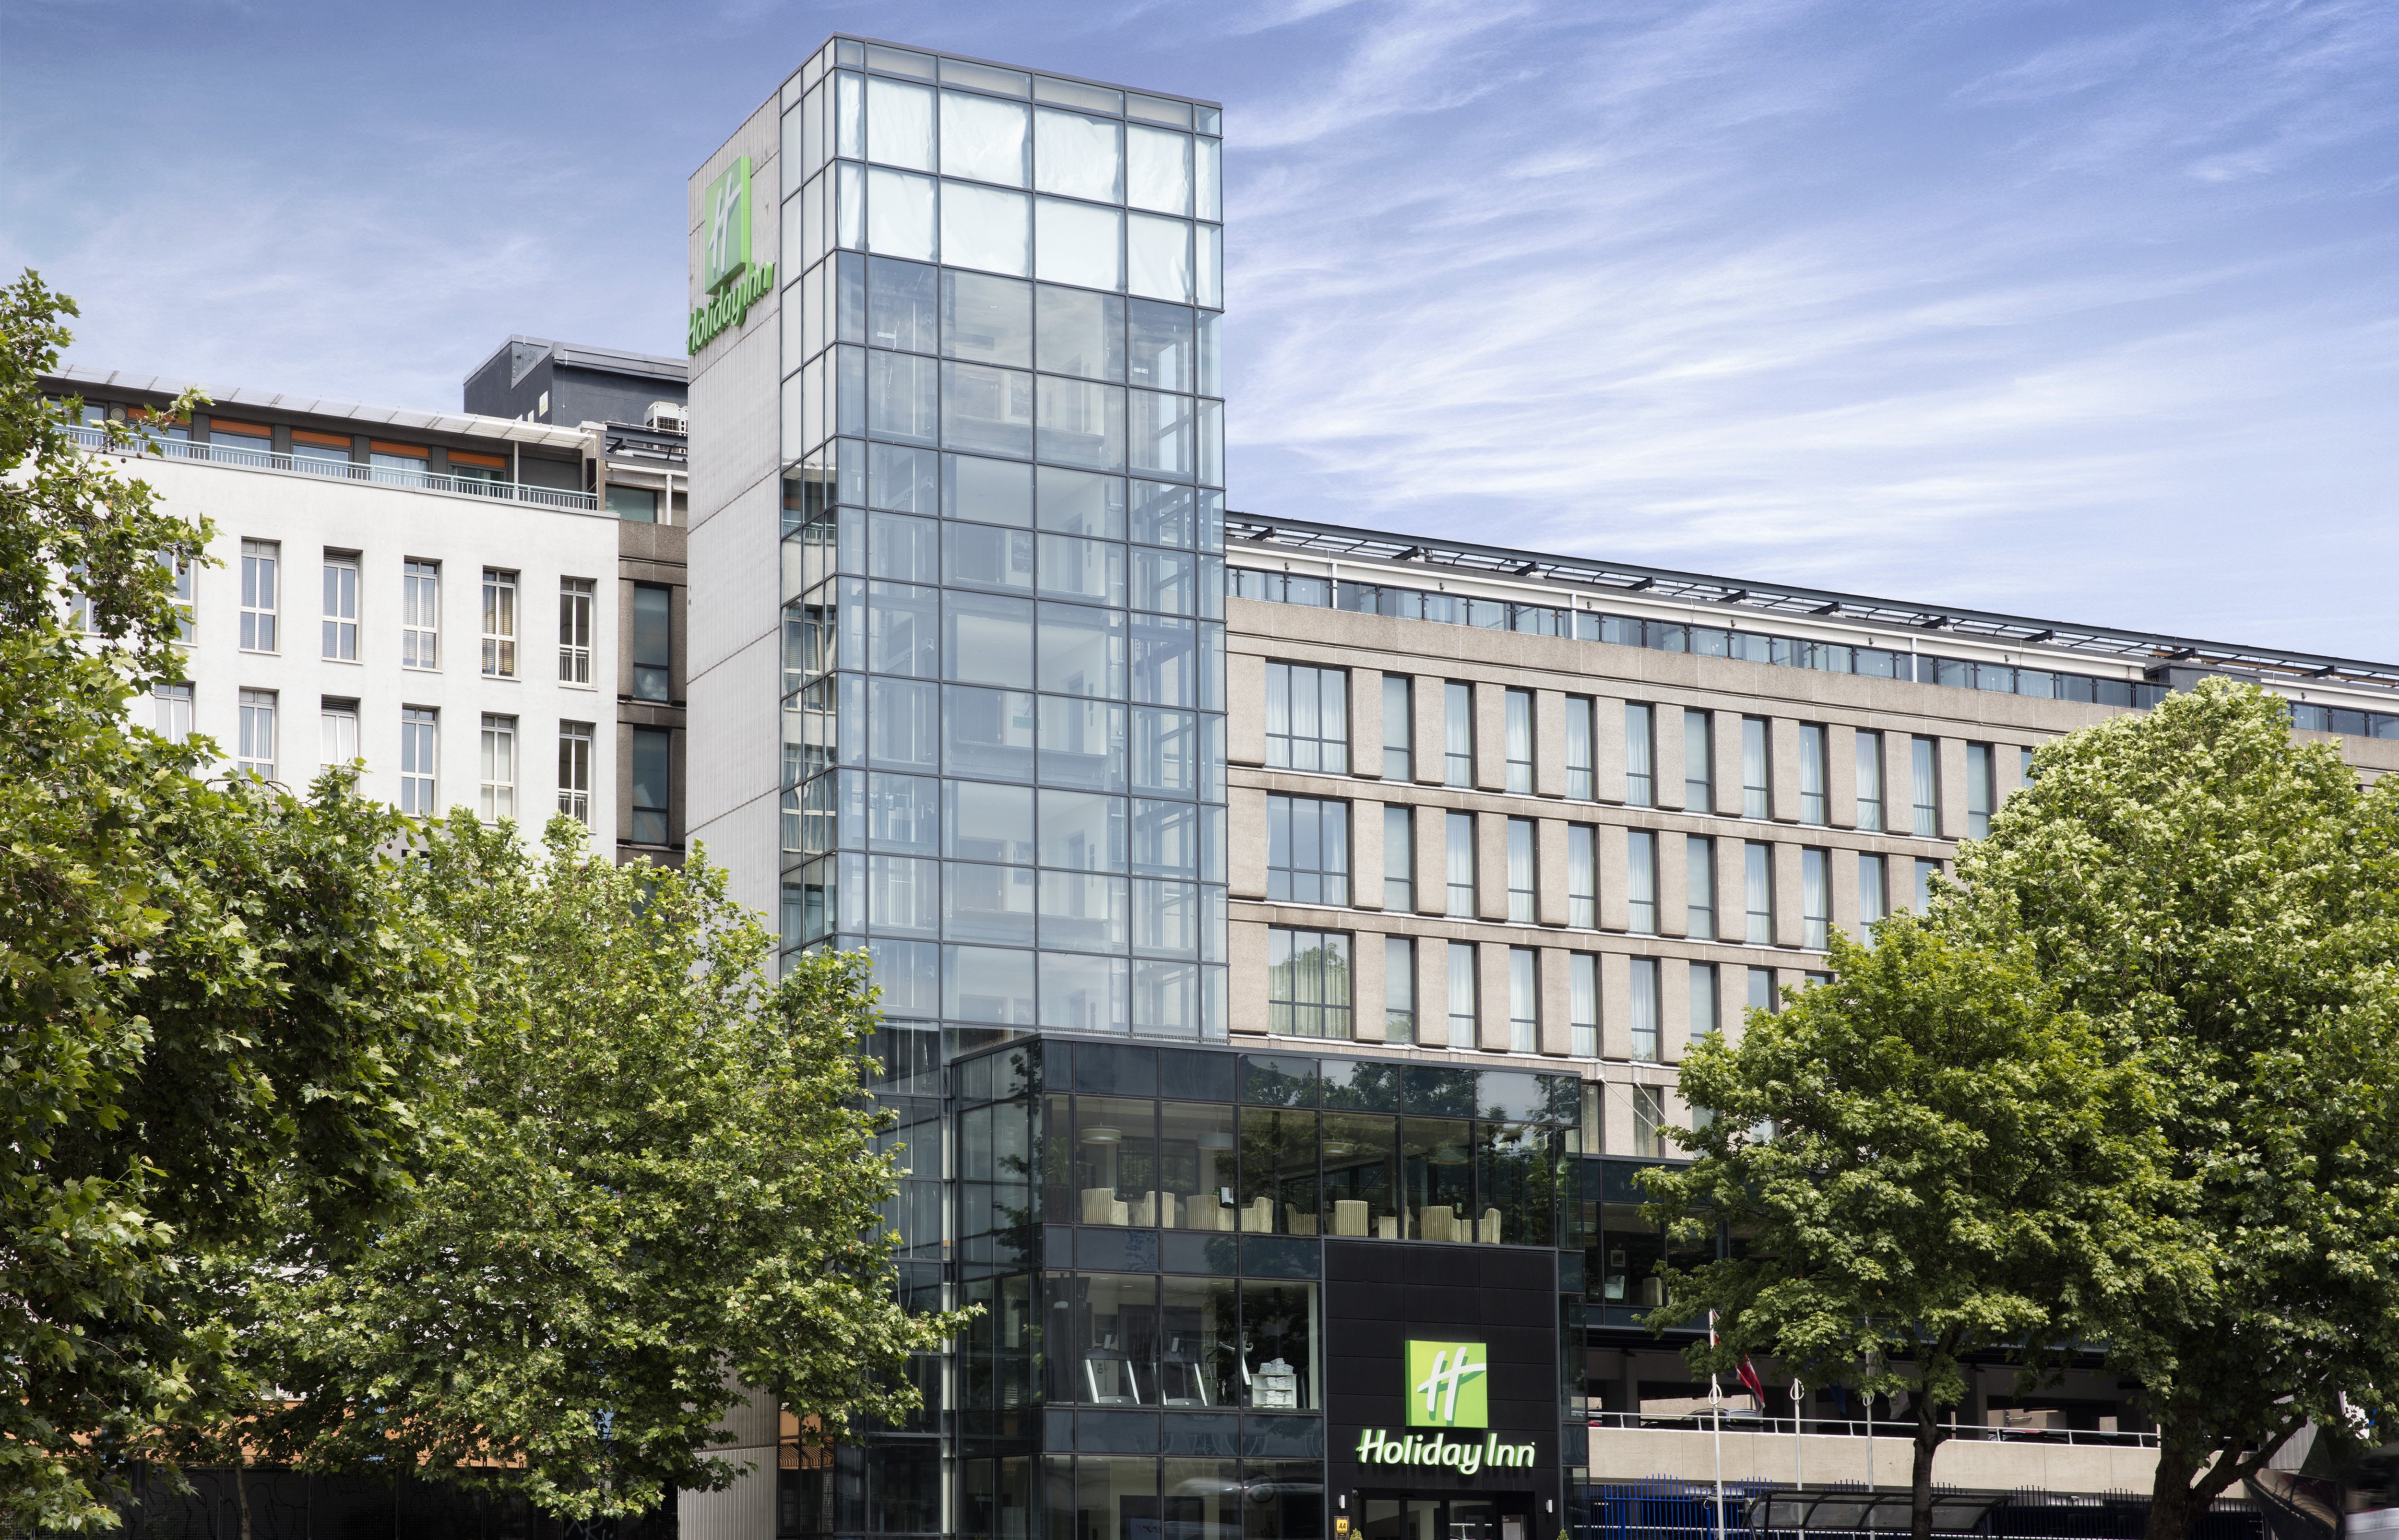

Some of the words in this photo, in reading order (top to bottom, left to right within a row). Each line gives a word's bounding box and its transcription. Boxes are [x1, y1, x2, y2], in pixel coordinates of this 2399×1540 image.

[686, 283, 747, 355] Holiday
[744, 262, 773, 306] Inn
[1355, 1429, 1483, 1475] Holiday
[1484, 1433, 1535, 1468] Inn
